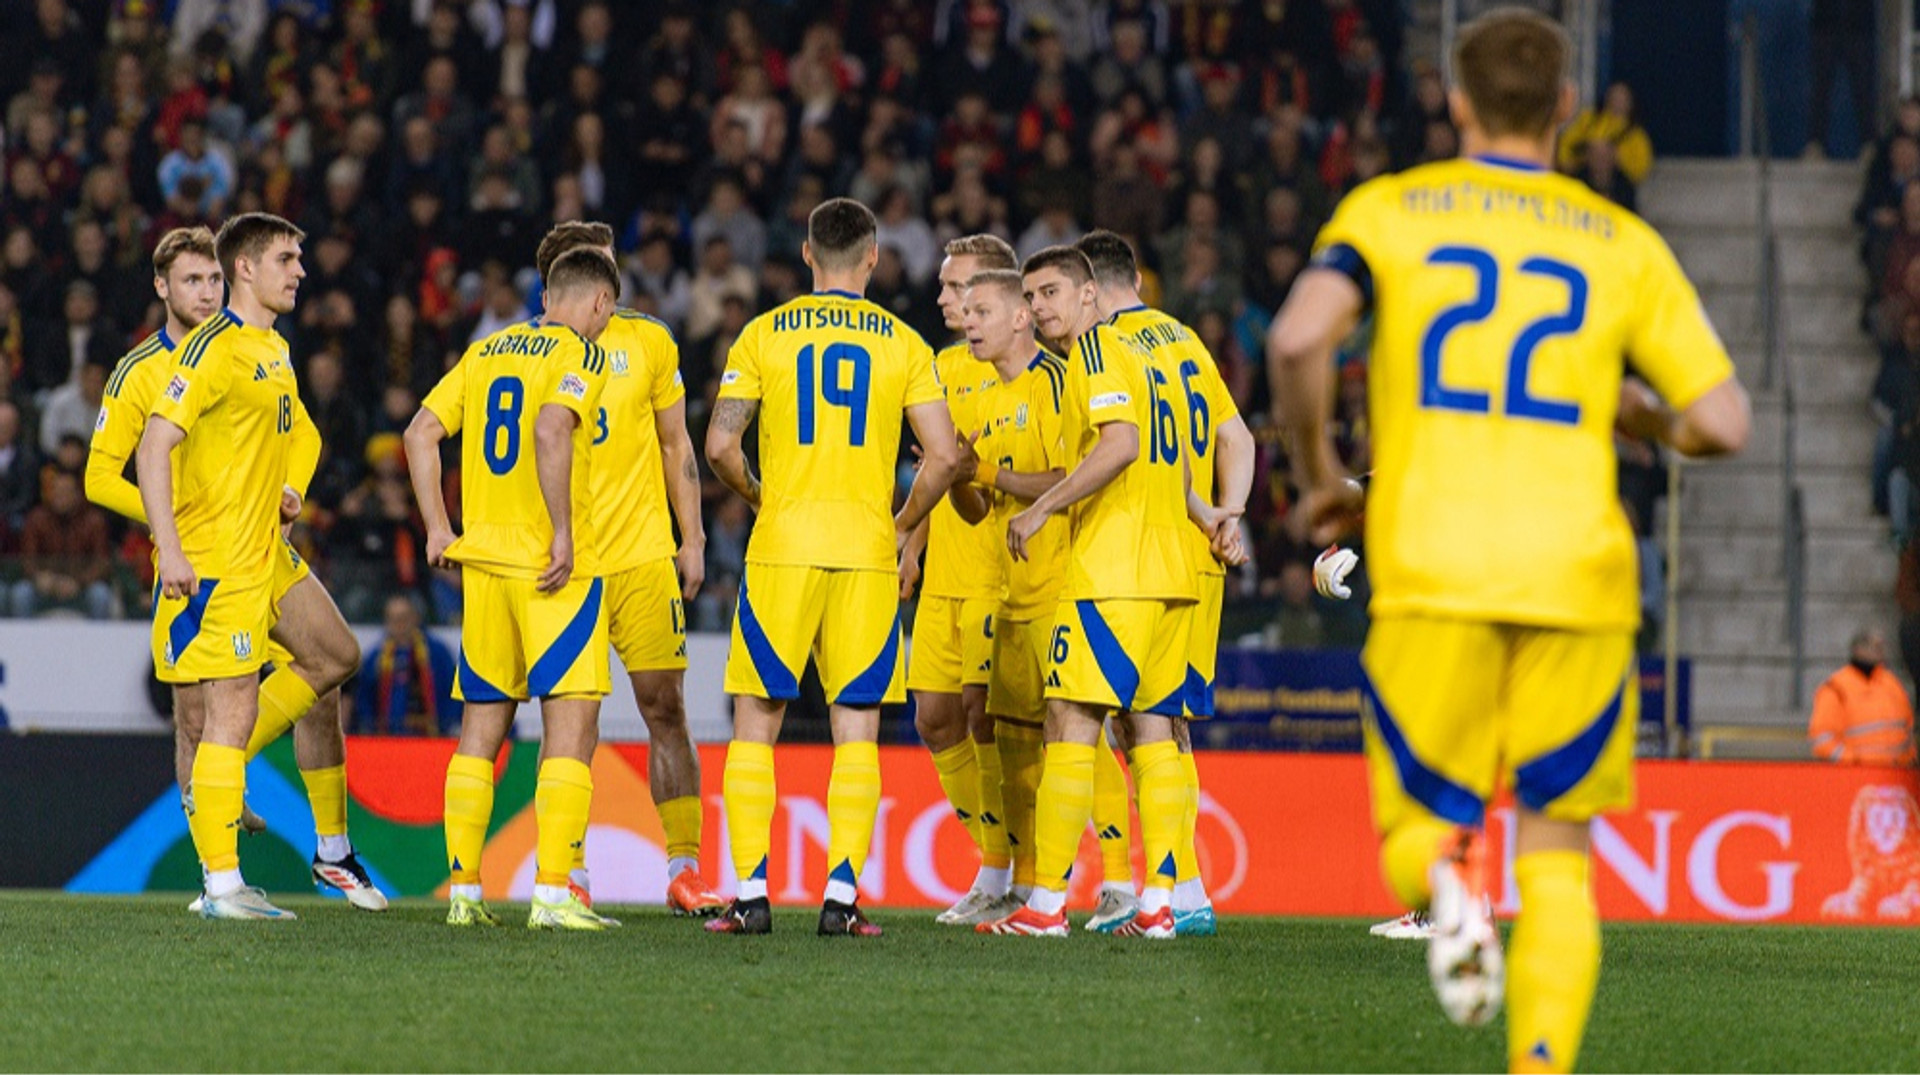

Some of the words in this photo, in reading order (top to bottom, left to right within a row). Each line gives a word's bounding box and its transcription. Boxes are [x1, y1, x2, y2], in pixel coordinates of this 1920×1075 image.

[773, 306, 894, 338] HUTSULIAK
[1420, 245, 1589, 426] 22
[276, 393, 292, 435] 18
[483, 374, 525, 477] 8
[591, 406, 609, 446] 3
[796, 341, 871, 447] 19
[1144, 365, 1179, 466] 16
[1491, 807, 1802, 920] ING
